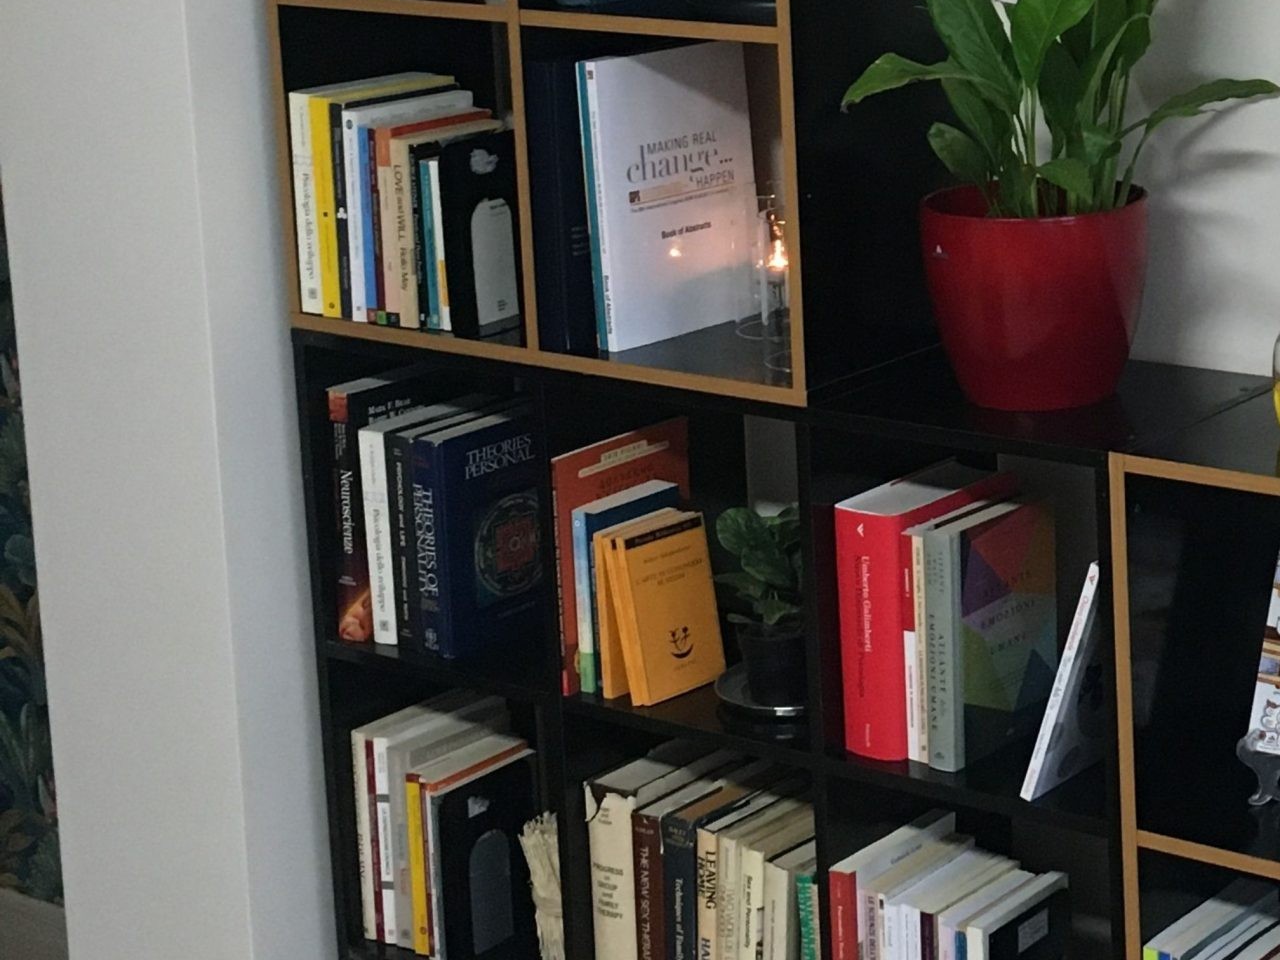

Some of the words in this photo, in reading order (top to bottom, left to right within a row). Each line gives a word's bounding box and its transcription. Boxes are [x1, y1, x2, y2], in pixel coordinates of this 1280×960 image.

[646, 135, 689, 155] MAKING
[692, 130, 718, 146] REAL
[392, 164, 404, 194] LOVE
[695, 169, 735, 189] HAPPEN
[396, 196, 405, 214] and
[396, 214, 408, 242] WILL
[661, 229, 677, 240] Book
[677, 226, 684, 236] of
[466, 433, 533, 465] THEORIES
[339, 468, 357, 555] Neuroscienze
[399, 529, 407, 547] LIFE
[412, 483, 429, 598] PERSONALITY
[422, 487, 438, 572] THEORIES
[424, 572, 439, 597] OF
[860, 555, 871, 599] Umberto
[862, 599, 874, 653] Galimberti
[928, 613, 939, 681] EMOZIONI
[938, 633, 947, 695] ATLANTE
[929, 685, 939, 731] UMANE
[639, 845, 650, 869] THE
[640, 869, 651, 899] NEW
[698, 855, 706, 899] HOME
[705, 850, 718, 910] LEAVING
[640, 899, 651, 921] SEX
[674, 877, 684, 922] Techniques
[867, 895, 875, 905] LE
[743, 907, 753, 949] Personality
